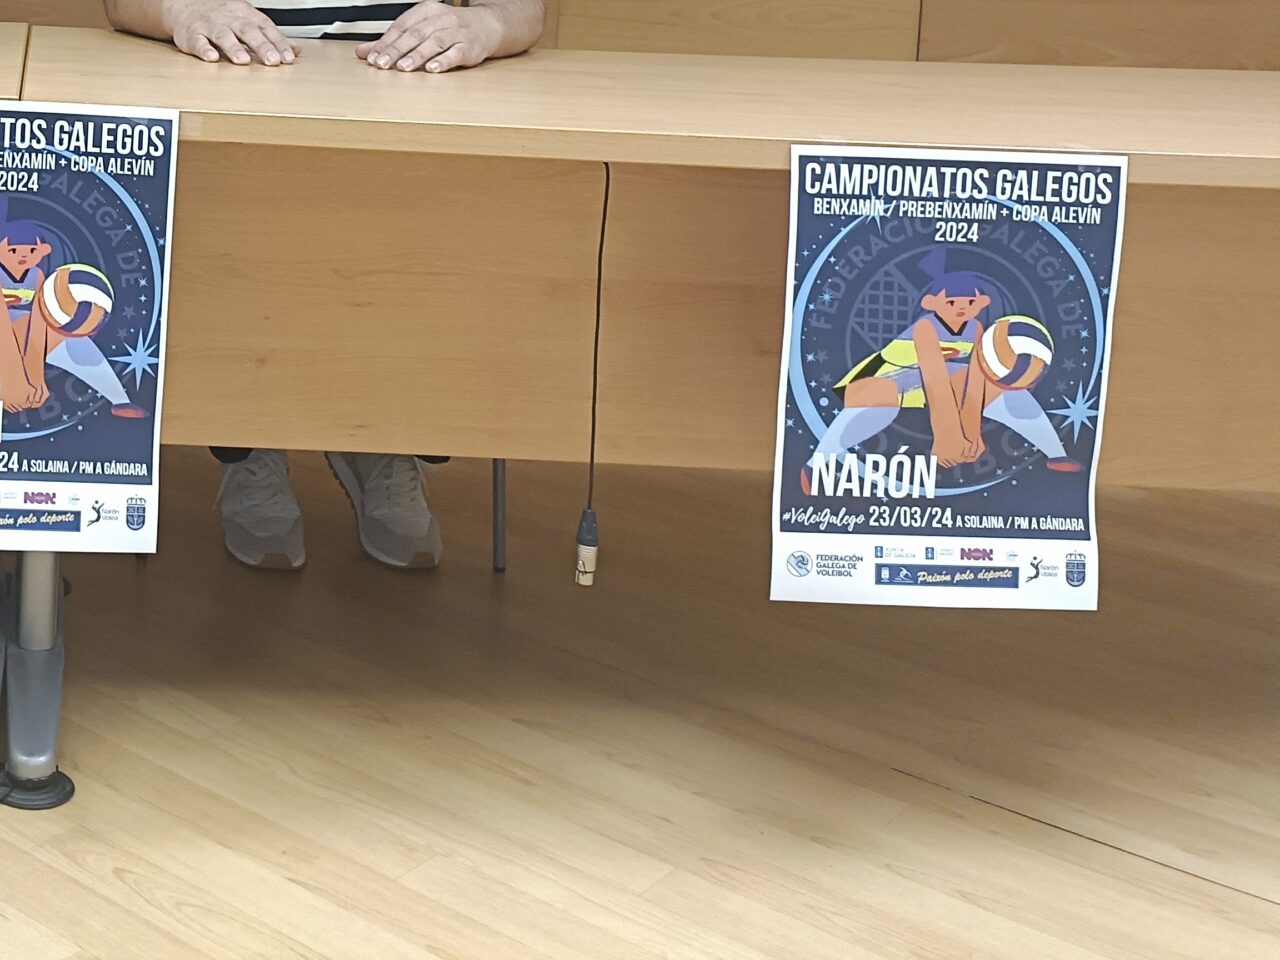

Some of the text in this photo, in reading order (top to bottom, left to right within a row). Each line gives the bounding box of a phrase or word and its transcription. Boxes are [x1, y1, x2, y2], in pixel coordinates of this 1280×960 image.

[53, 120, 166, 157] GALEGOS
[70, 155, 105, 172] COPA
[107, 156, 155, 177] ALEVÍN
[805, 162, 1113, 205] CAMPIONATOS GALEGOS
[813, 197, 884, 216] BENXAMÍN
[899, 200, 998, 220] PREBENXAMÍN
[1012, 205, 1048, 222] COPA
[1051, 204, 1102, 225] ALEVÍN
[934, 221, 979, 243] 2024
[21, 459, 29, 472] A
[30, 459, 69, 474] SOLAINA
[79, 461, 94, 474] PM
[95, 461, 103, 474] A
[104, 460, 148, 476] GÁNDARA
[811, 446, 937, 499] NARÓN
[782, 506, 865, 532] #VoleiGalego
[868, 505, 953, 528] 23/03/24
[956, 515, 963, 528] A
[964, 515, 1004, 529] SOLAINA
[1014, 516, 1029, 530] PM
[1031, 517, 1038, 530] A
[1039, 515, 1085, 531] GÁNDARA
[816, 554, 863, 562] FEDERACIÓN
[848, 562, 858, 570] DE
[816, 569, 853, 577] VOLEIBOL
